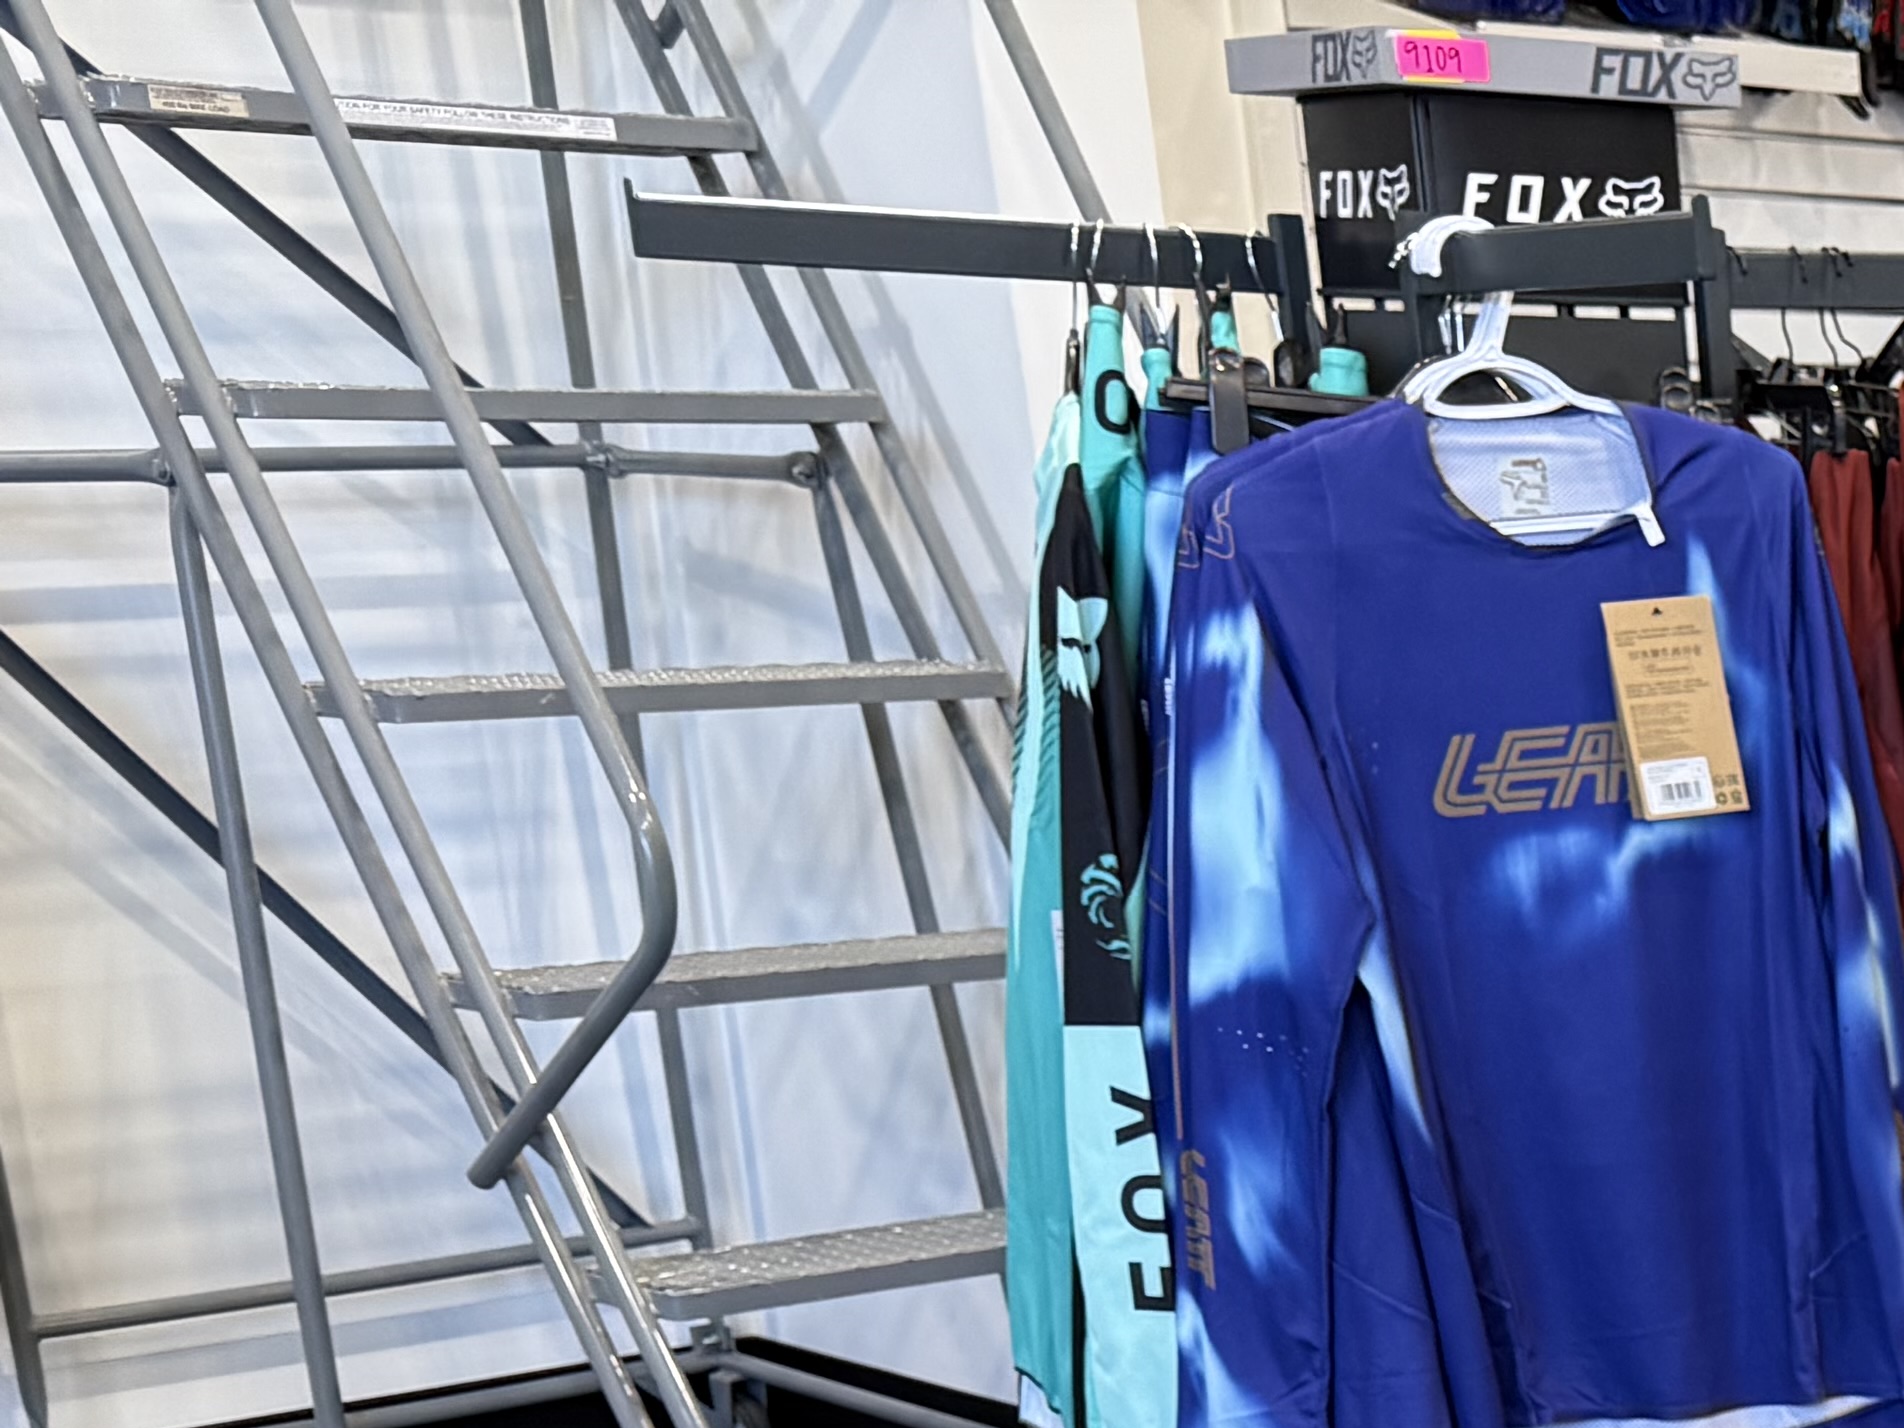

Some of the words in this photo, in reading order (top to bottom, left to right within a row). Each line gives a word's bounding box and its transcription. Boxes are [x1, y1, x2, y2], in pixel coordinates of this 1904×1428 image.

[1311, 33, 1352, 84] FOX
[1403, 40, 1462, 73] 9109
[1590, 45, 1684, 100] FOX
[1318, 168, 1377, 221] FOX
[1462, 171, 1592, 224] FOX
[1433, 721, 1628, 818] LEA
